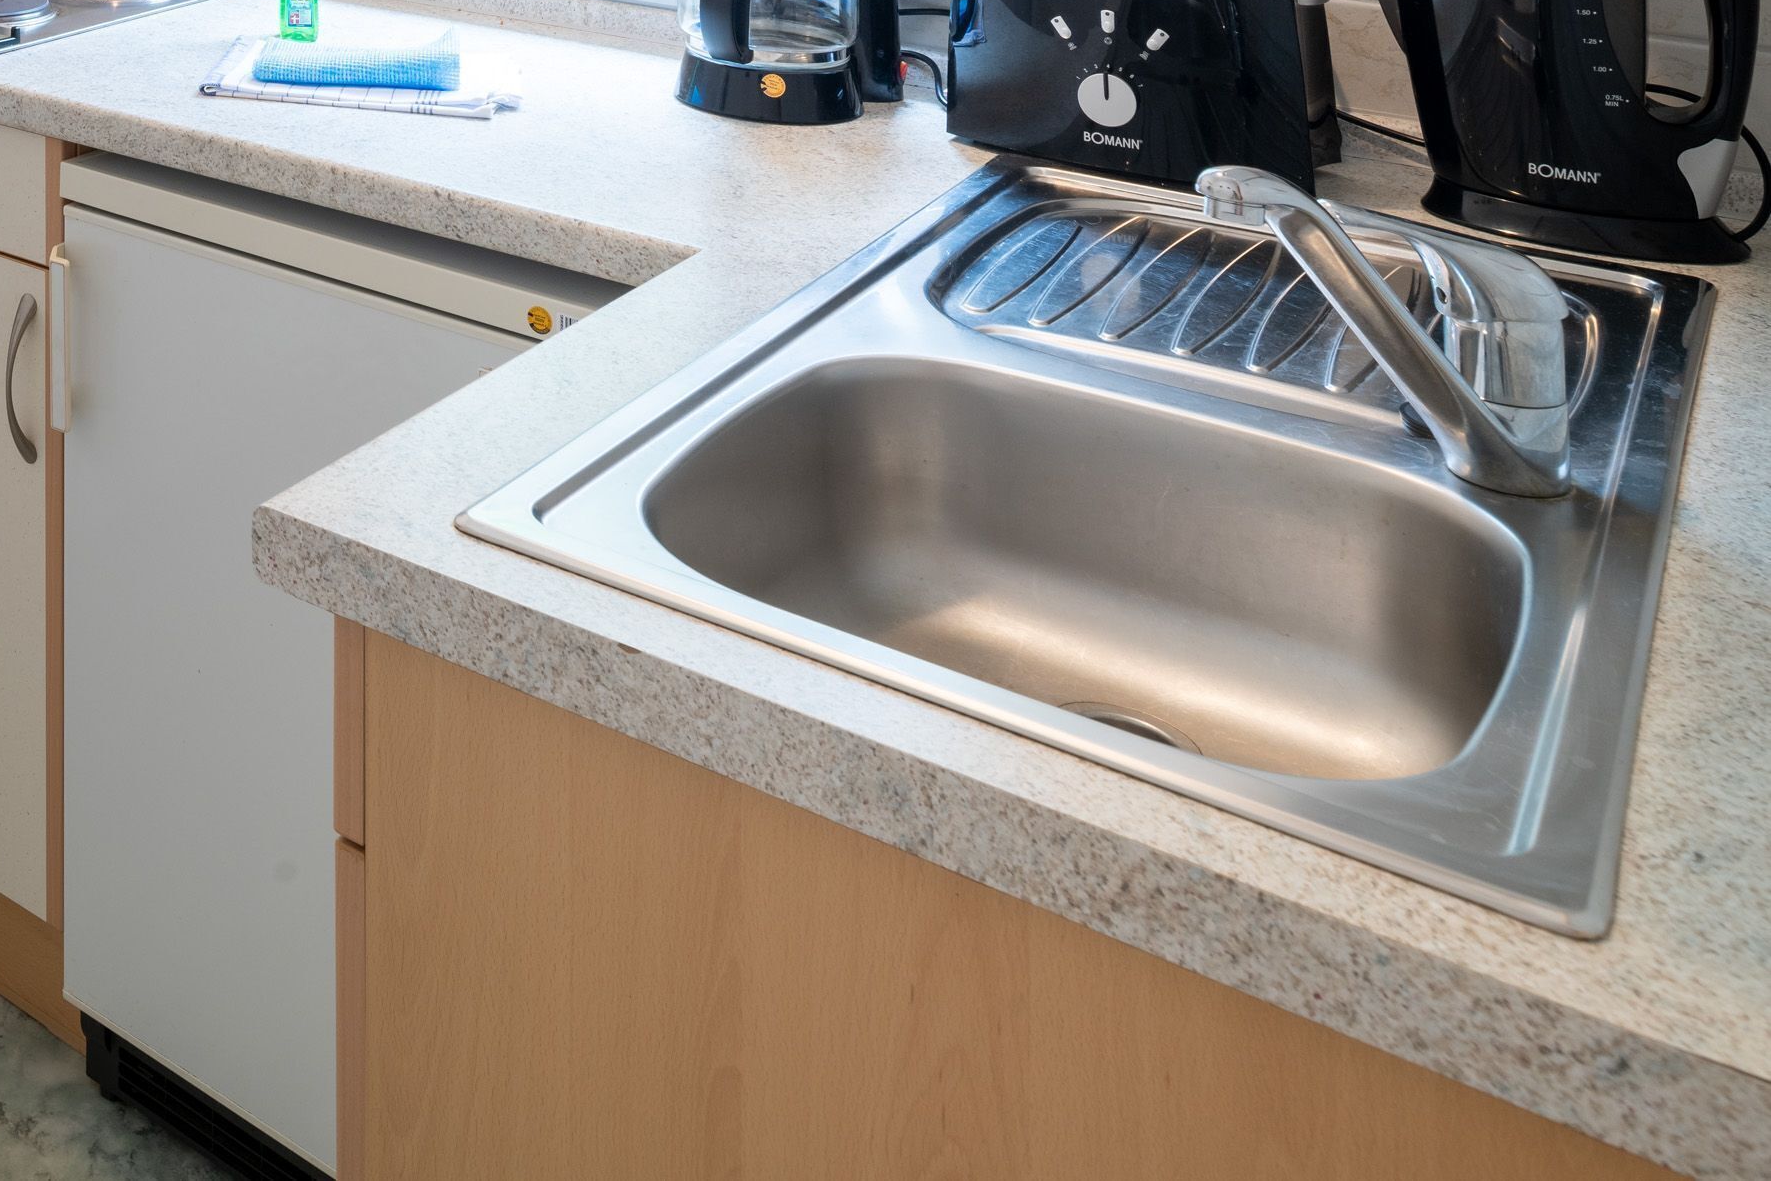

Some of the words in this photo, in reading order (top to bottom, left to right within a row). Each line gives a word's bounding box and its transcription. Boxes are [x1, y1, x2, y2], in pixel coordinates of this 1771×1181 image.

[1605, 94, 1624, 102] 0.75L
[1083, 131, 1140, 150] BOMANN
[1528, 162, 1597, 184] BOMANN
